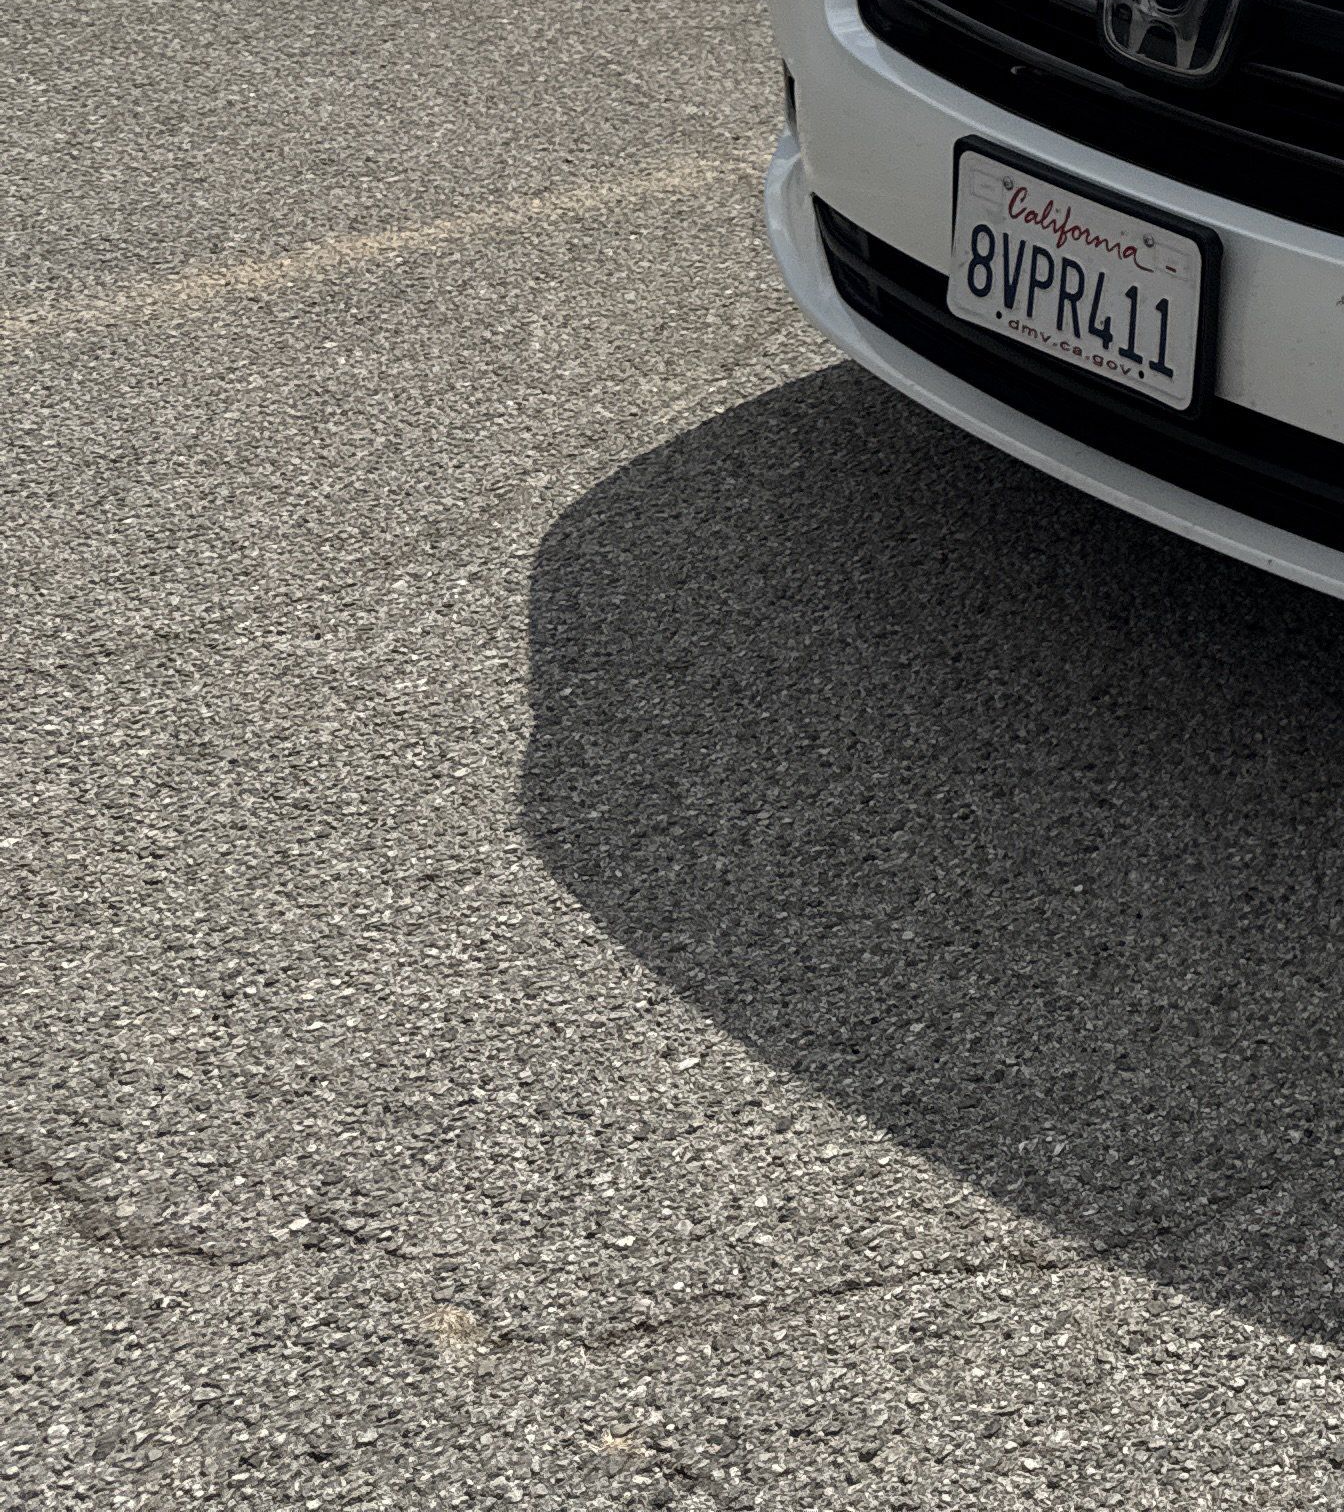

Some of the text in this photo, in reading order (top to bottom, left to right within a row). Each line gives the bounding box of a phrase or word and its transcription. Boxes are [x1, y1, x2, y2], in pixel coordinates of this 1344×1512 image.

[1007, 186, 1154, 273] California
[967, 223, 1174, 379] 8VPR411
[1008, 318, 1132, 376] dmv.ca.gov
